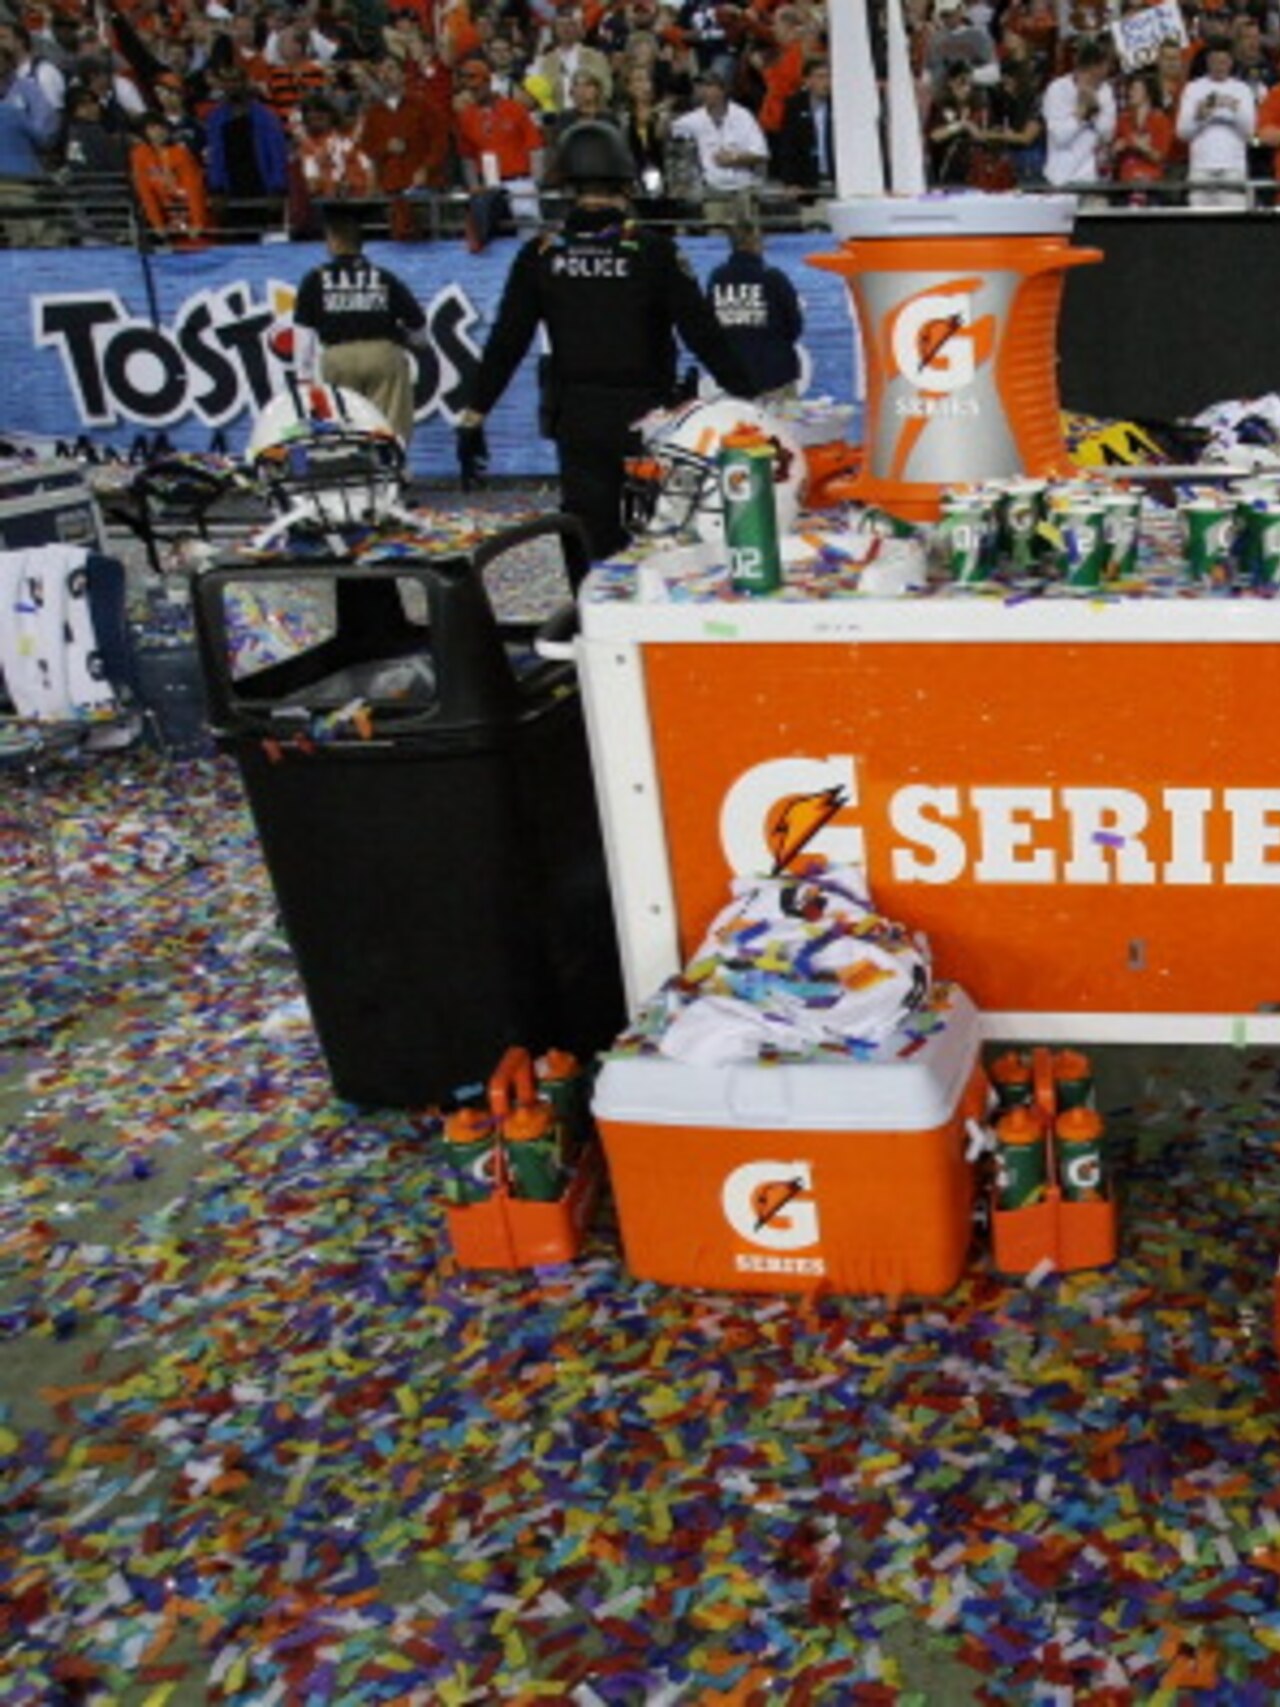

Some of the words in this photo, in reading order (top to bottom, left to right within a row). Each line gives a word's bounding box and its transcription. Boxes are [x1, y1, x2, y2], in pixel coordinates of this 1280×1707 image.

[552, 256, 629, 277] POLICE
[894, 396, 979, 416] SERIES
[735, 1252, 826, 1276] SERIES
